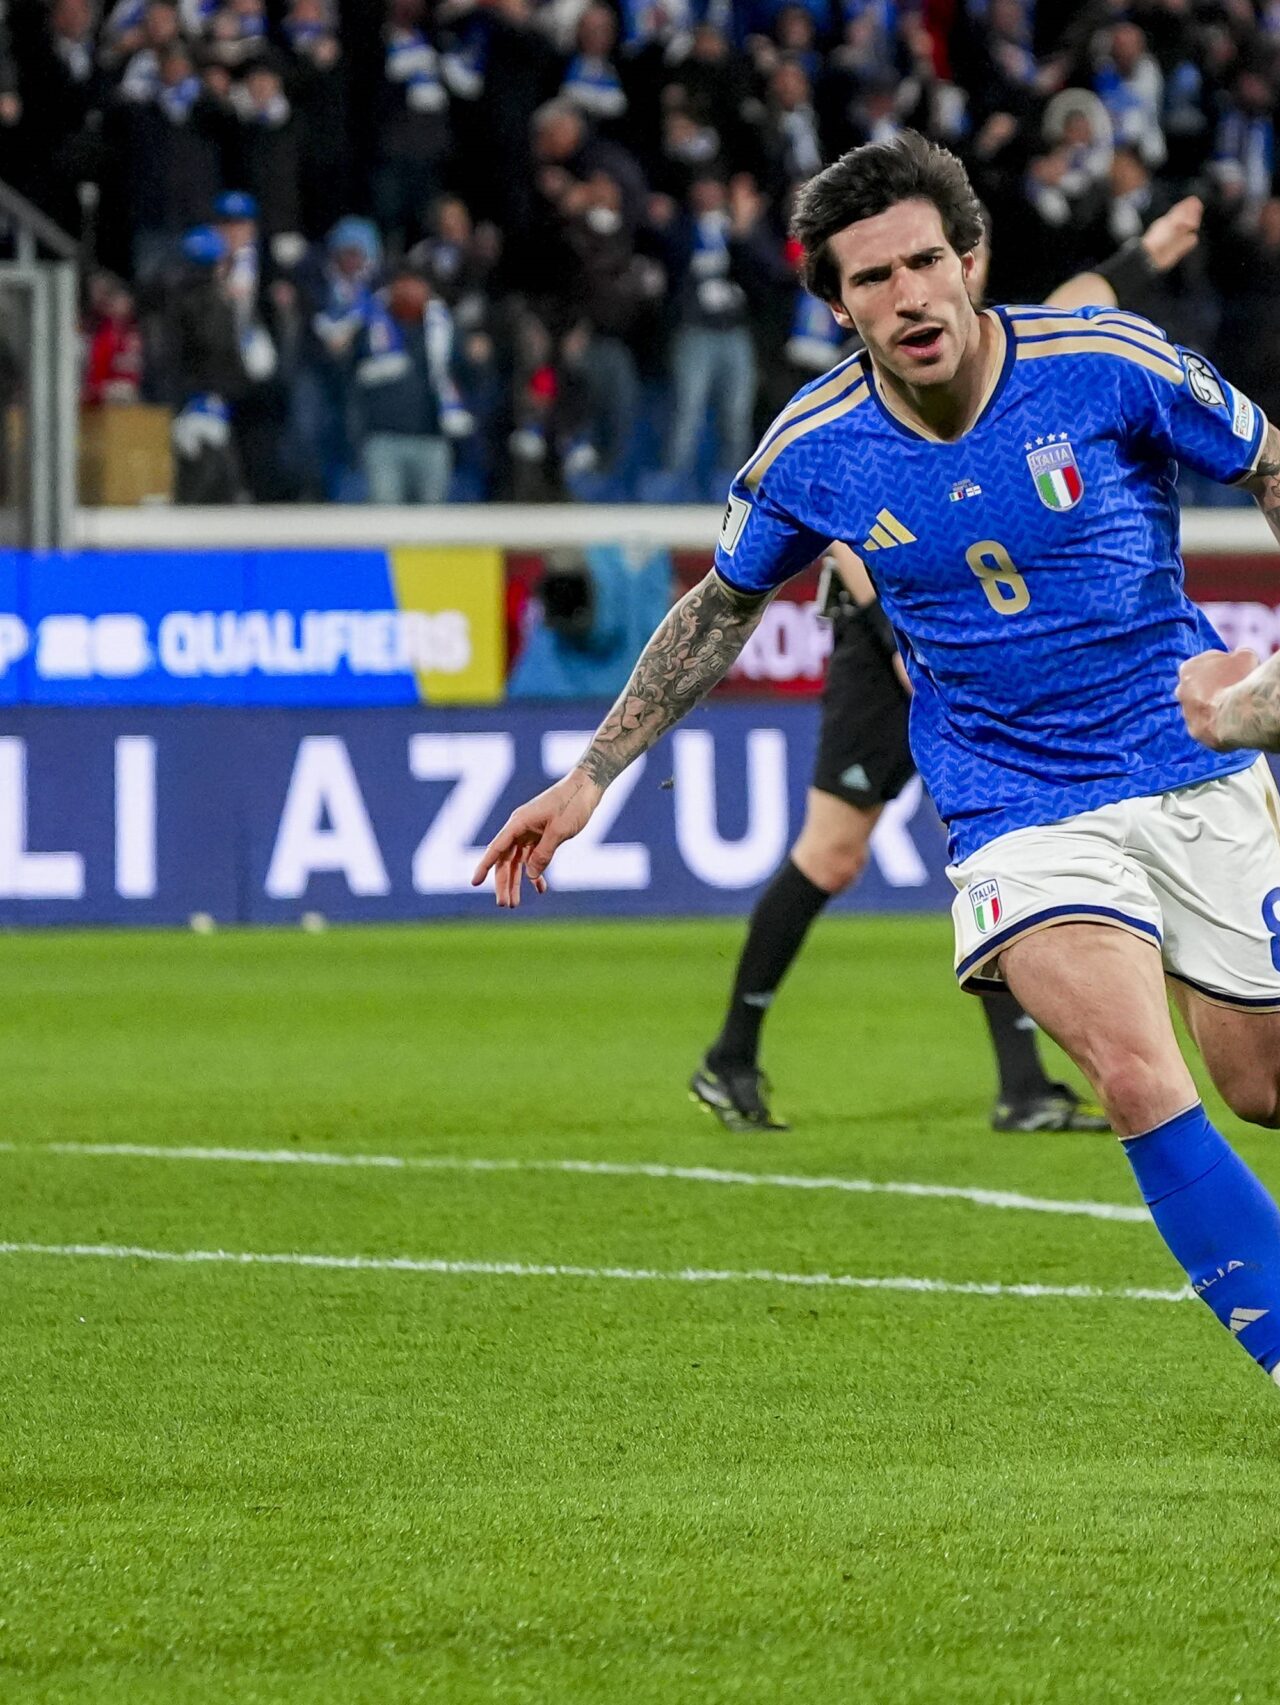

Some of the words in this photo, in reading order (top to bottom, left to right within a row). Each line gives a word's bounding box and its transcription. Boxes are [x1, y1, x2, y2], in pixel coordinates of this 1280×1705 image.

[1031, 448, 1070, 466] ITALIA
[965, 540, 1031, 615] 8
[158, 610, 471, 678] QUALIFIERS
[972, 883, 996, 903] ITALIA
